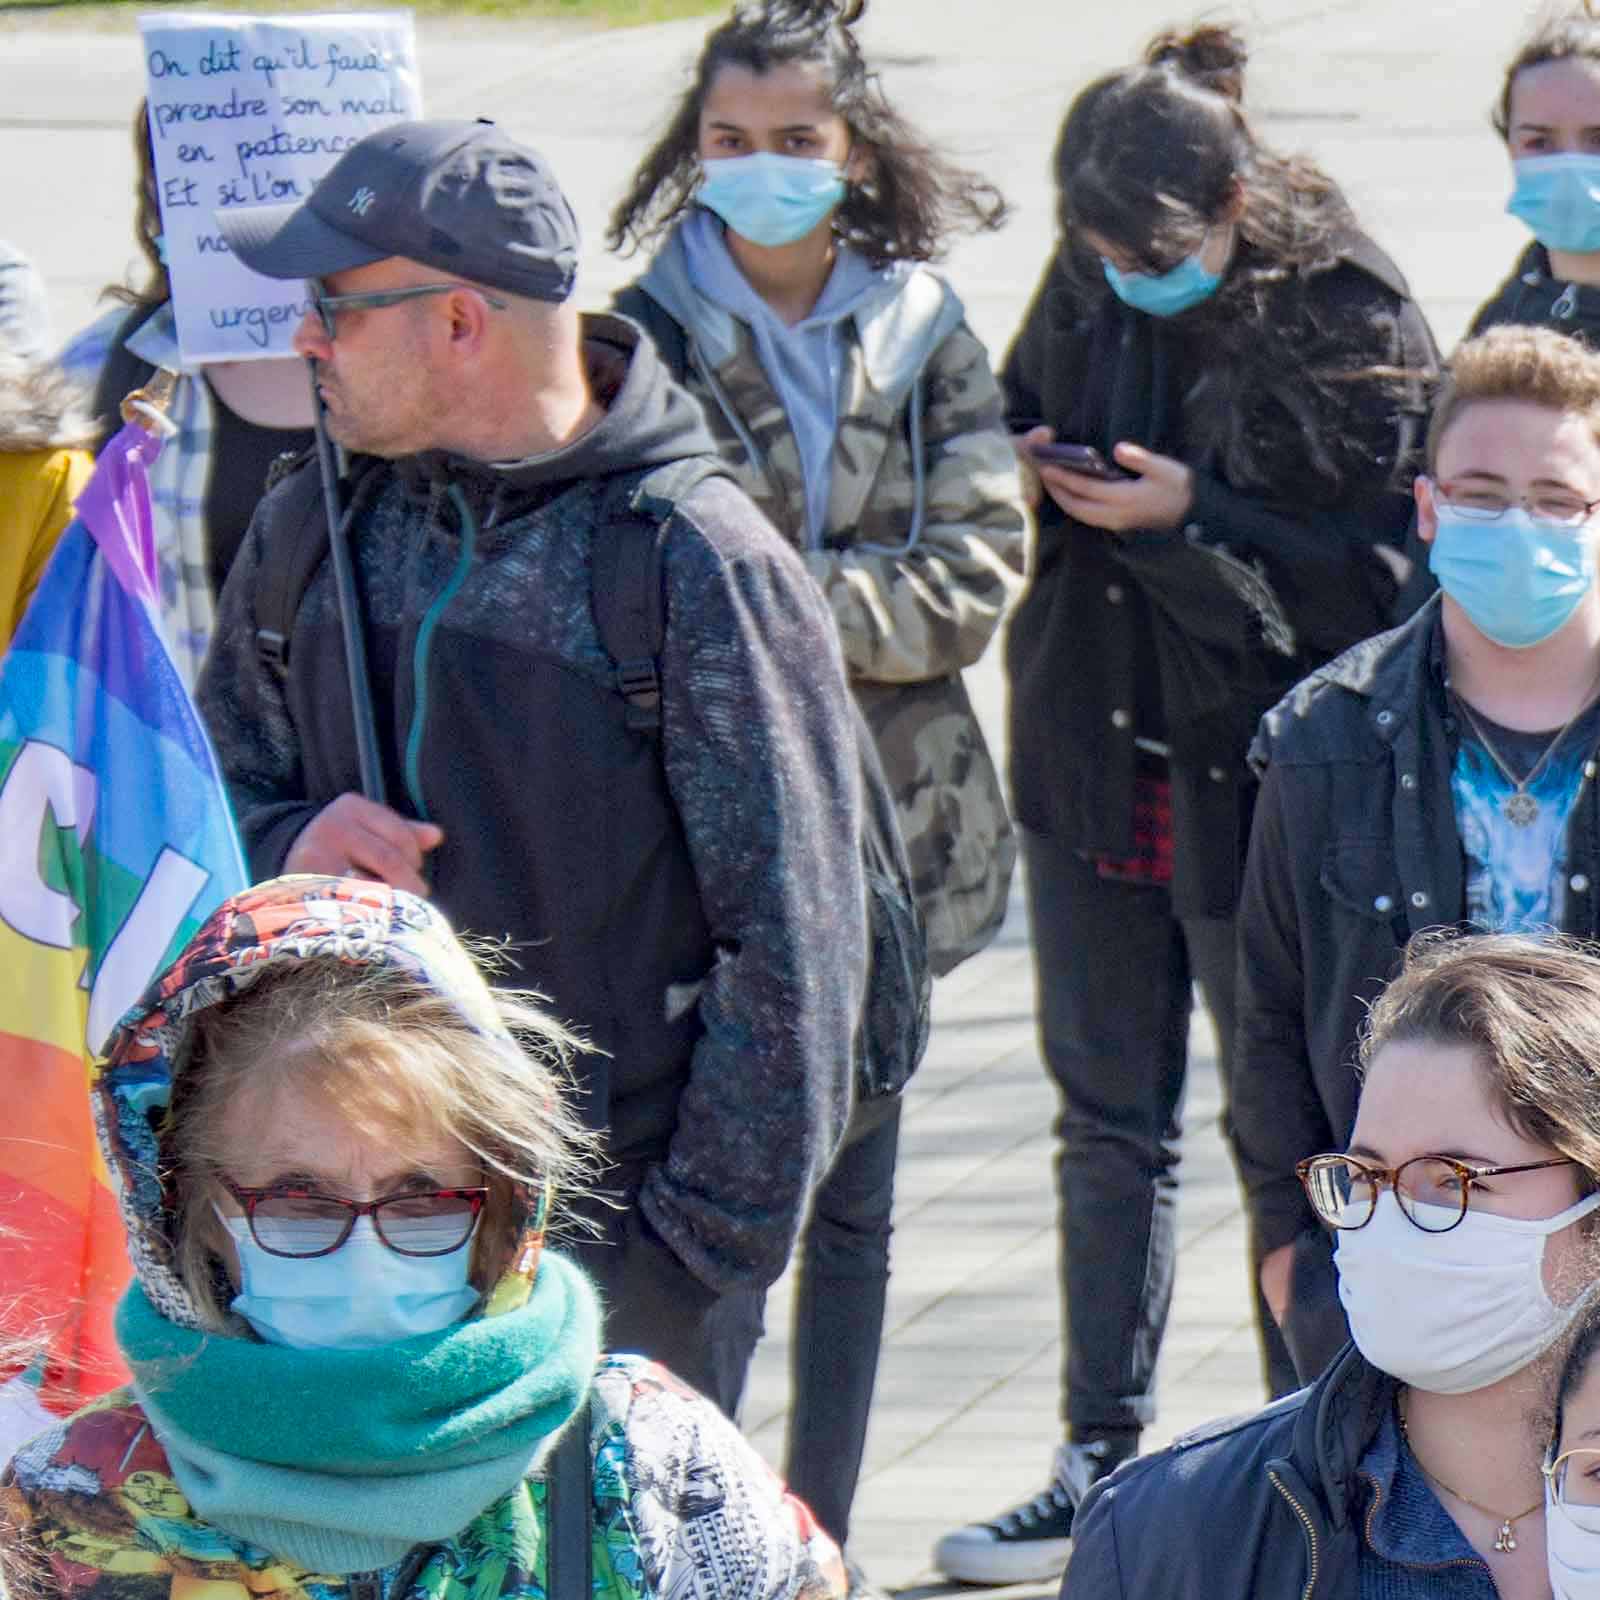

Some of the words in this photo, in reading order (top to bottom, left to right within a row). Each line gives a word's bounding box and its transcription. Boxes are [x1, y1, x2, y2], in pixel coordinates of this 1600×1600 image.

[150, 49, 188, 78] On
[200, 38, 241, 74] dit
[154, 87, 268, 138] prendre
[283, 98, 330, 117] son
[340, 96, 405, 117] mal
[177, 143, 214, 163] en
[163, 177, 199, 208] Et
[208, 300, 306, 349] urgen
